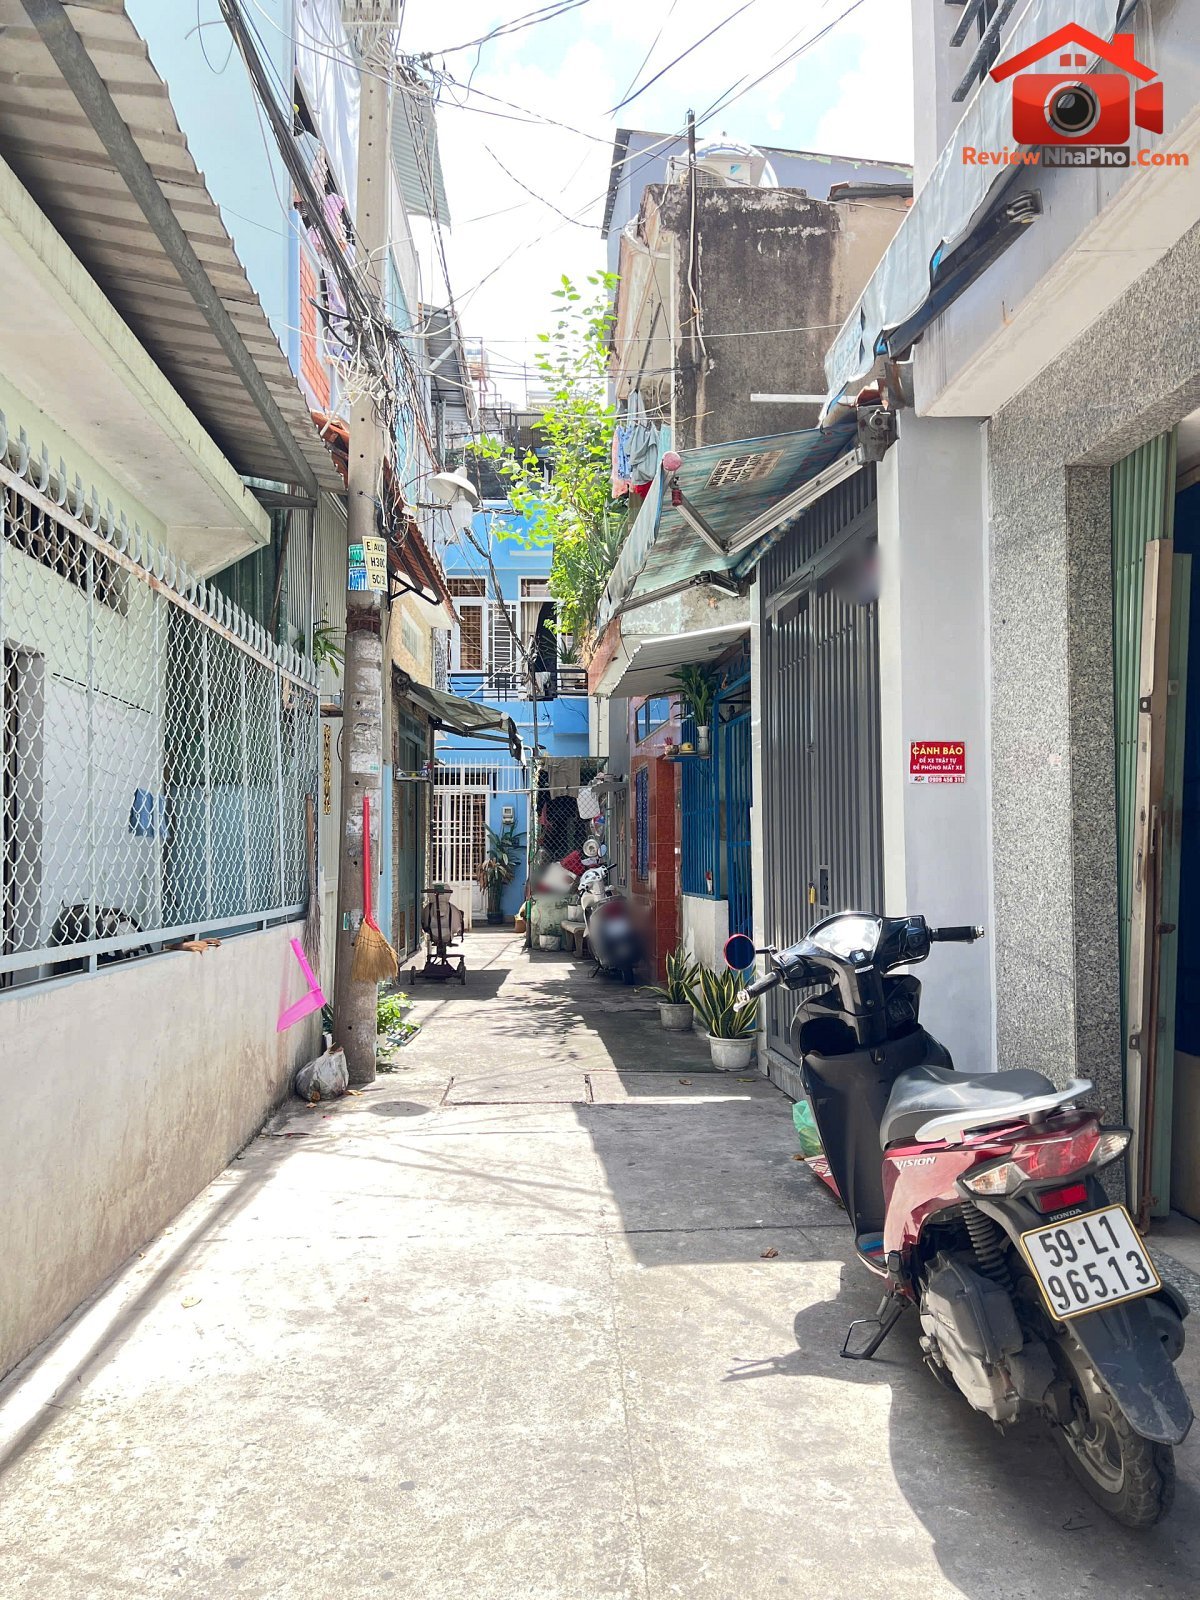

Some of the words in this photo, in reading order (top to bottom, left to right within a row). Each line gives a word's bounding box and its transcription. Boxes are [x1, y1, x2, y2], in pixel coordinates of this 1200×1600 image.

[912, 744, 940, 755] CẢNH
[943, 744, 963, 755] BÁO
[895, 1156, 936, 1169] VISION
[1050, 1208, 1082, 1222] HONDA
[1038, 1215, 1121, 1267] 59-L1
[1048, 1250, 1150, 1310] 965.13
